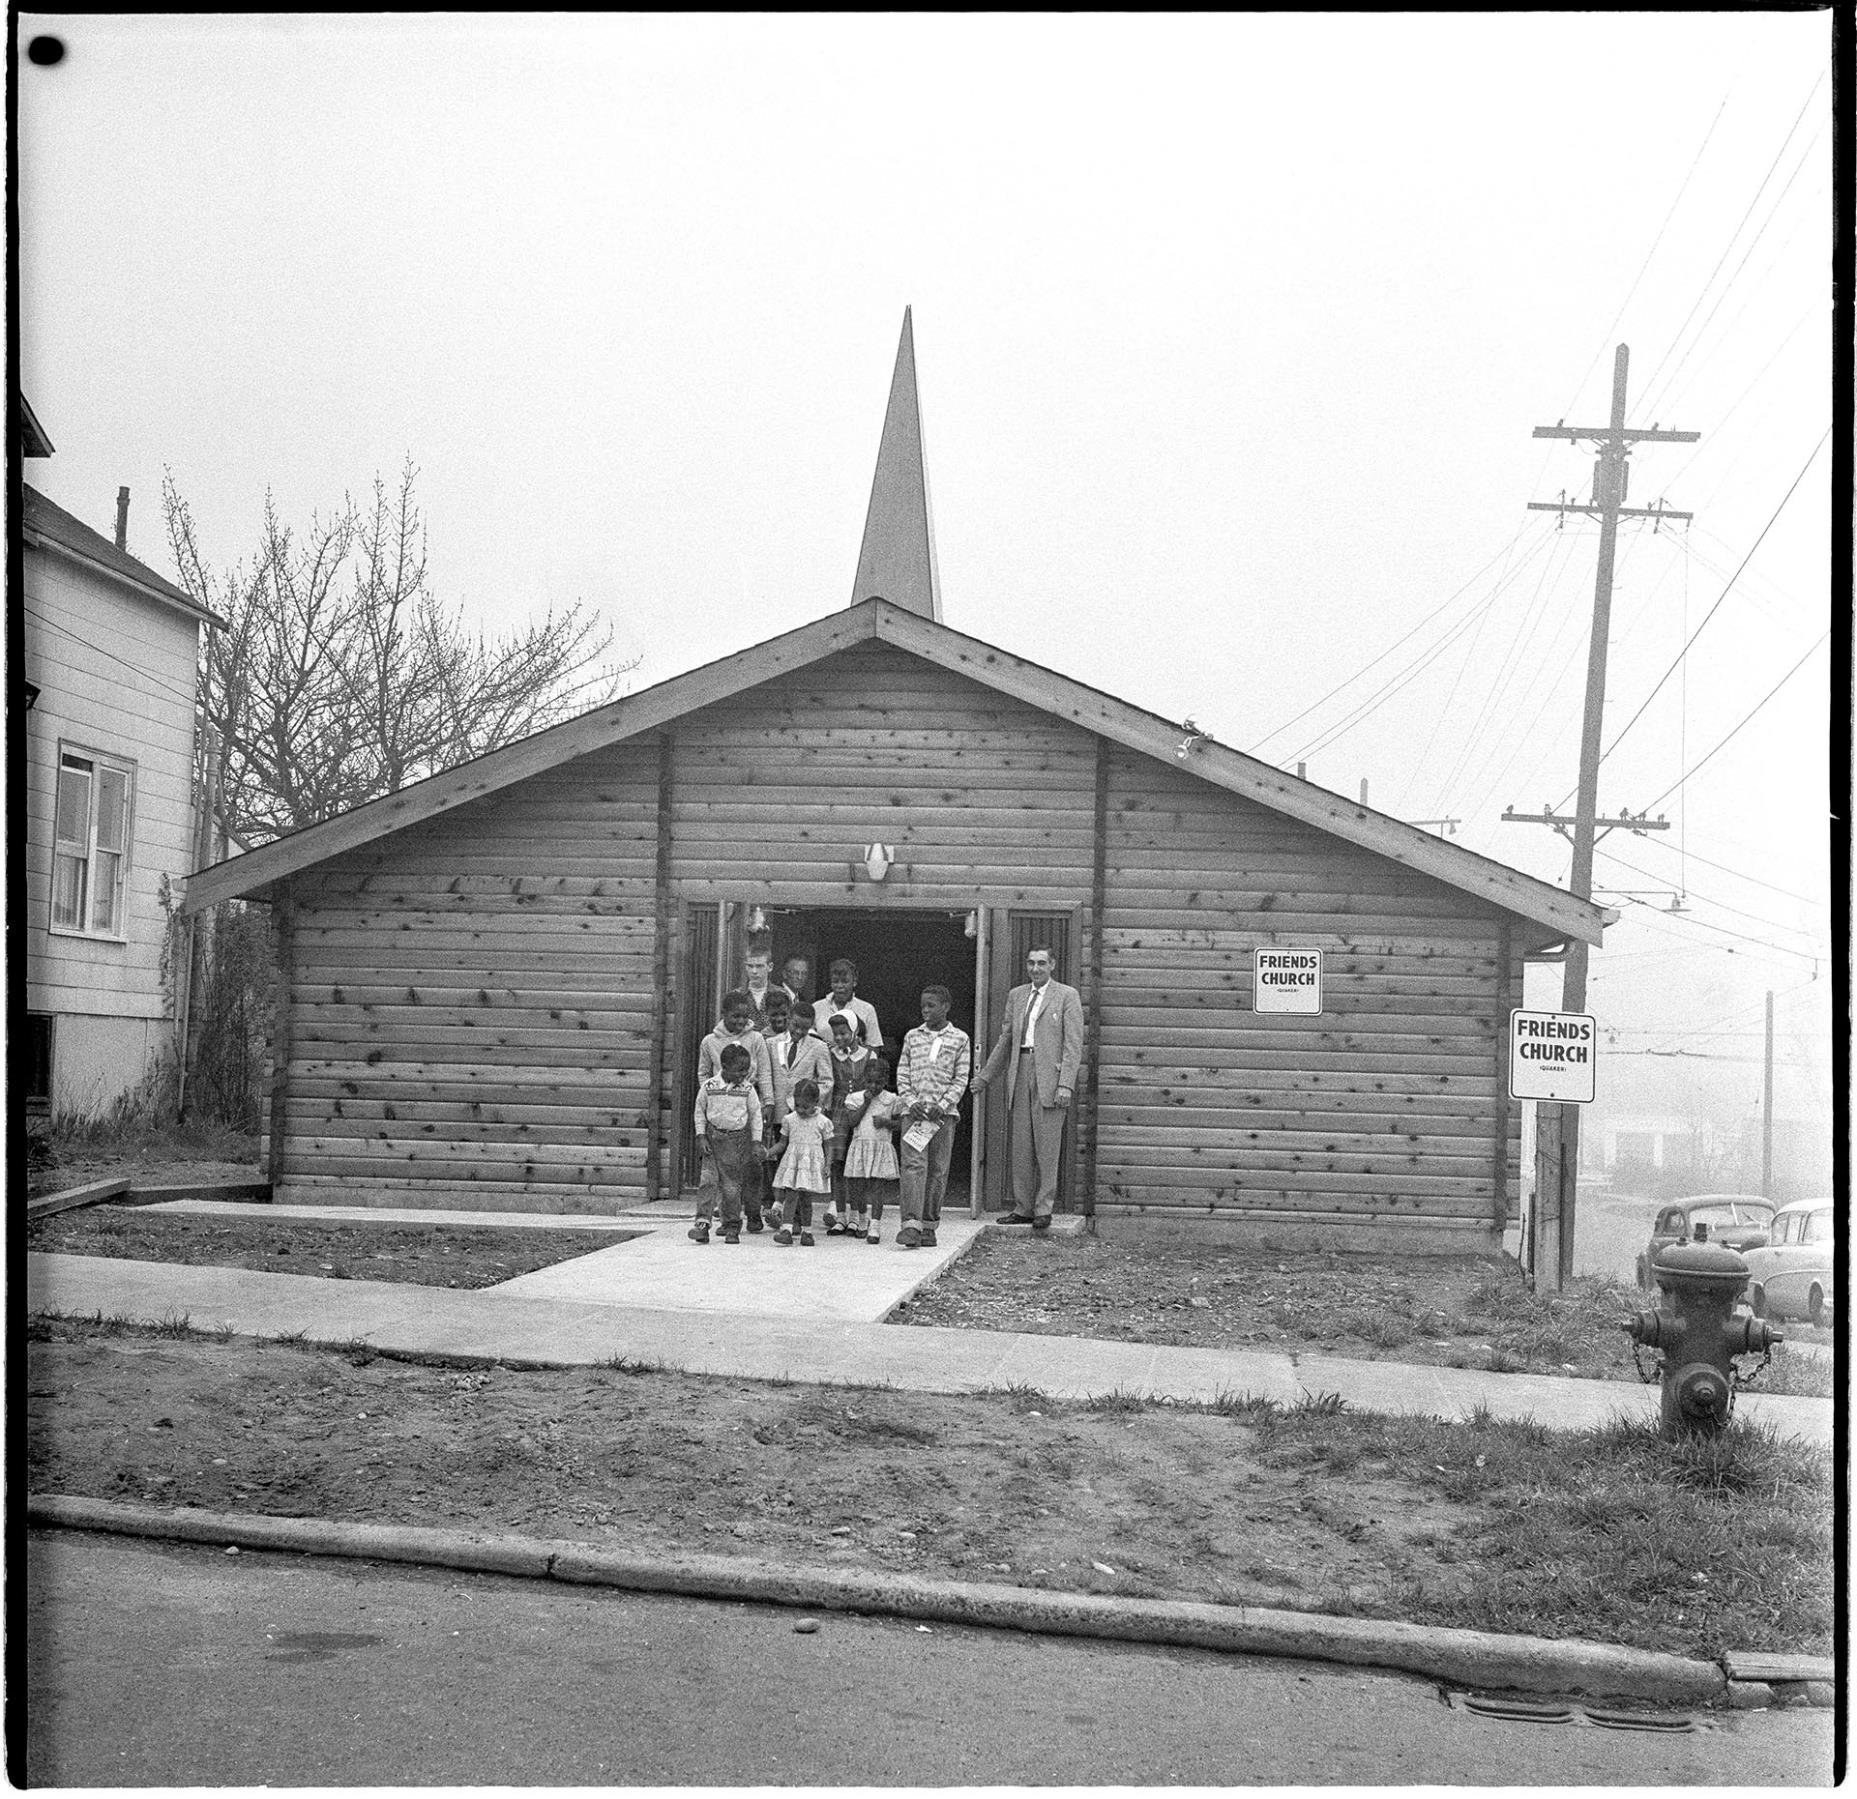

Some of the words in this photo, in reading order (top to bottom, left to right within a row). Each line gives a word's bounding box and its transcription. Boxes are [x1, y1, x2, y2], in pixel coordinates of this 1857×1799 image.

[1260, 956, 1317, 968] FRIENDS
[1262, 973, 1314, 985] CHURCH
[1518, 1019, 1590, 1040] FRIENDS
[1520, 1042, 1587, 1063] CHURCH
